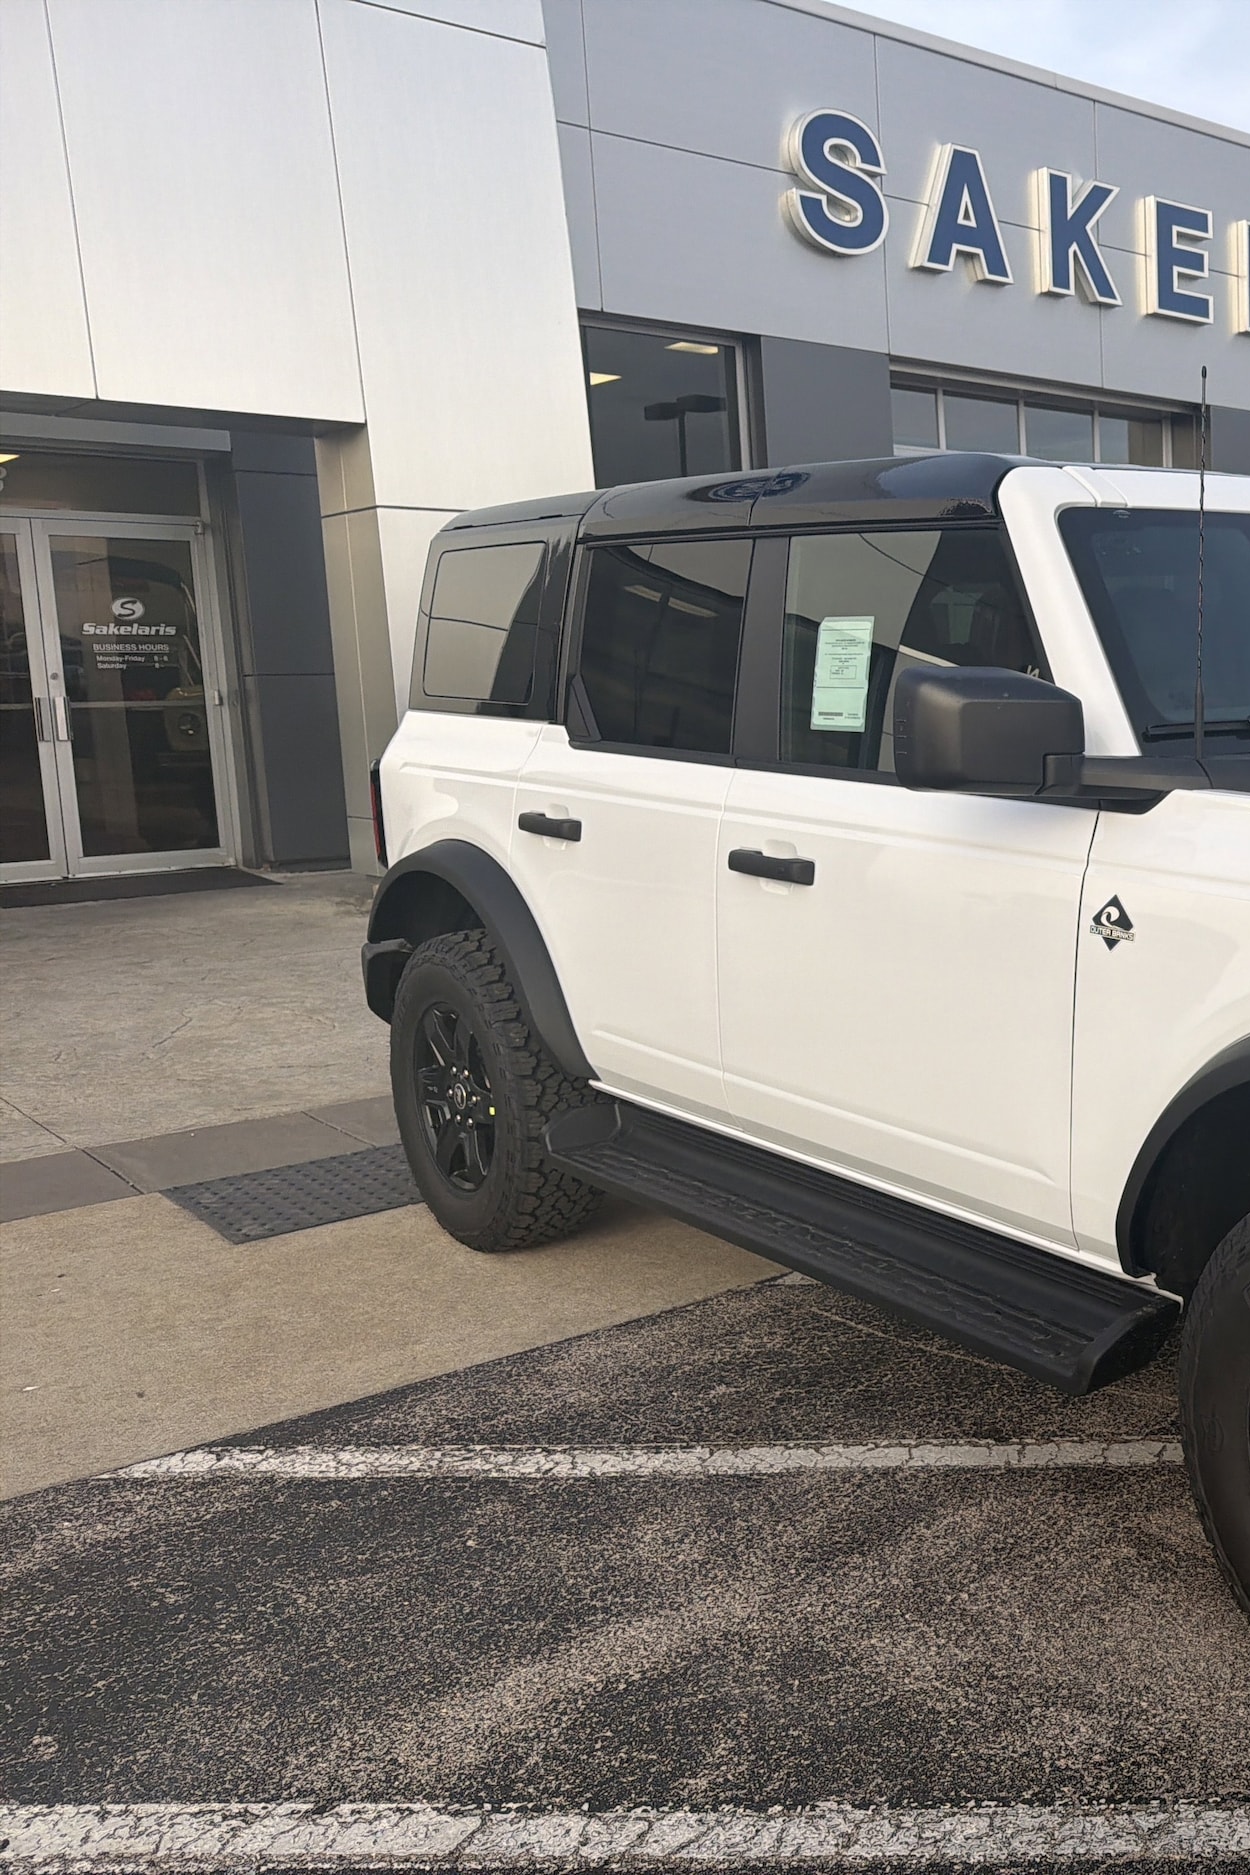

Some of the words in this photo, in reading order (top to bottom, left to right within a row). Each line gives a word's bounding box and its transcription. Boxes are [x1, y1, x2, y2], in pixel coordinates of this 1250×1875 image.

[82, 623, 176, 636] Sakelaris
[93, 643, 137, 652] BUSINESS
[139, 644, 170, 652] HOURS
[96, 655, 146, 663] Monday-Friday
[1090, 926, 1112, 937] OUTER
[1112, 929, 1135, 941] BANKS
